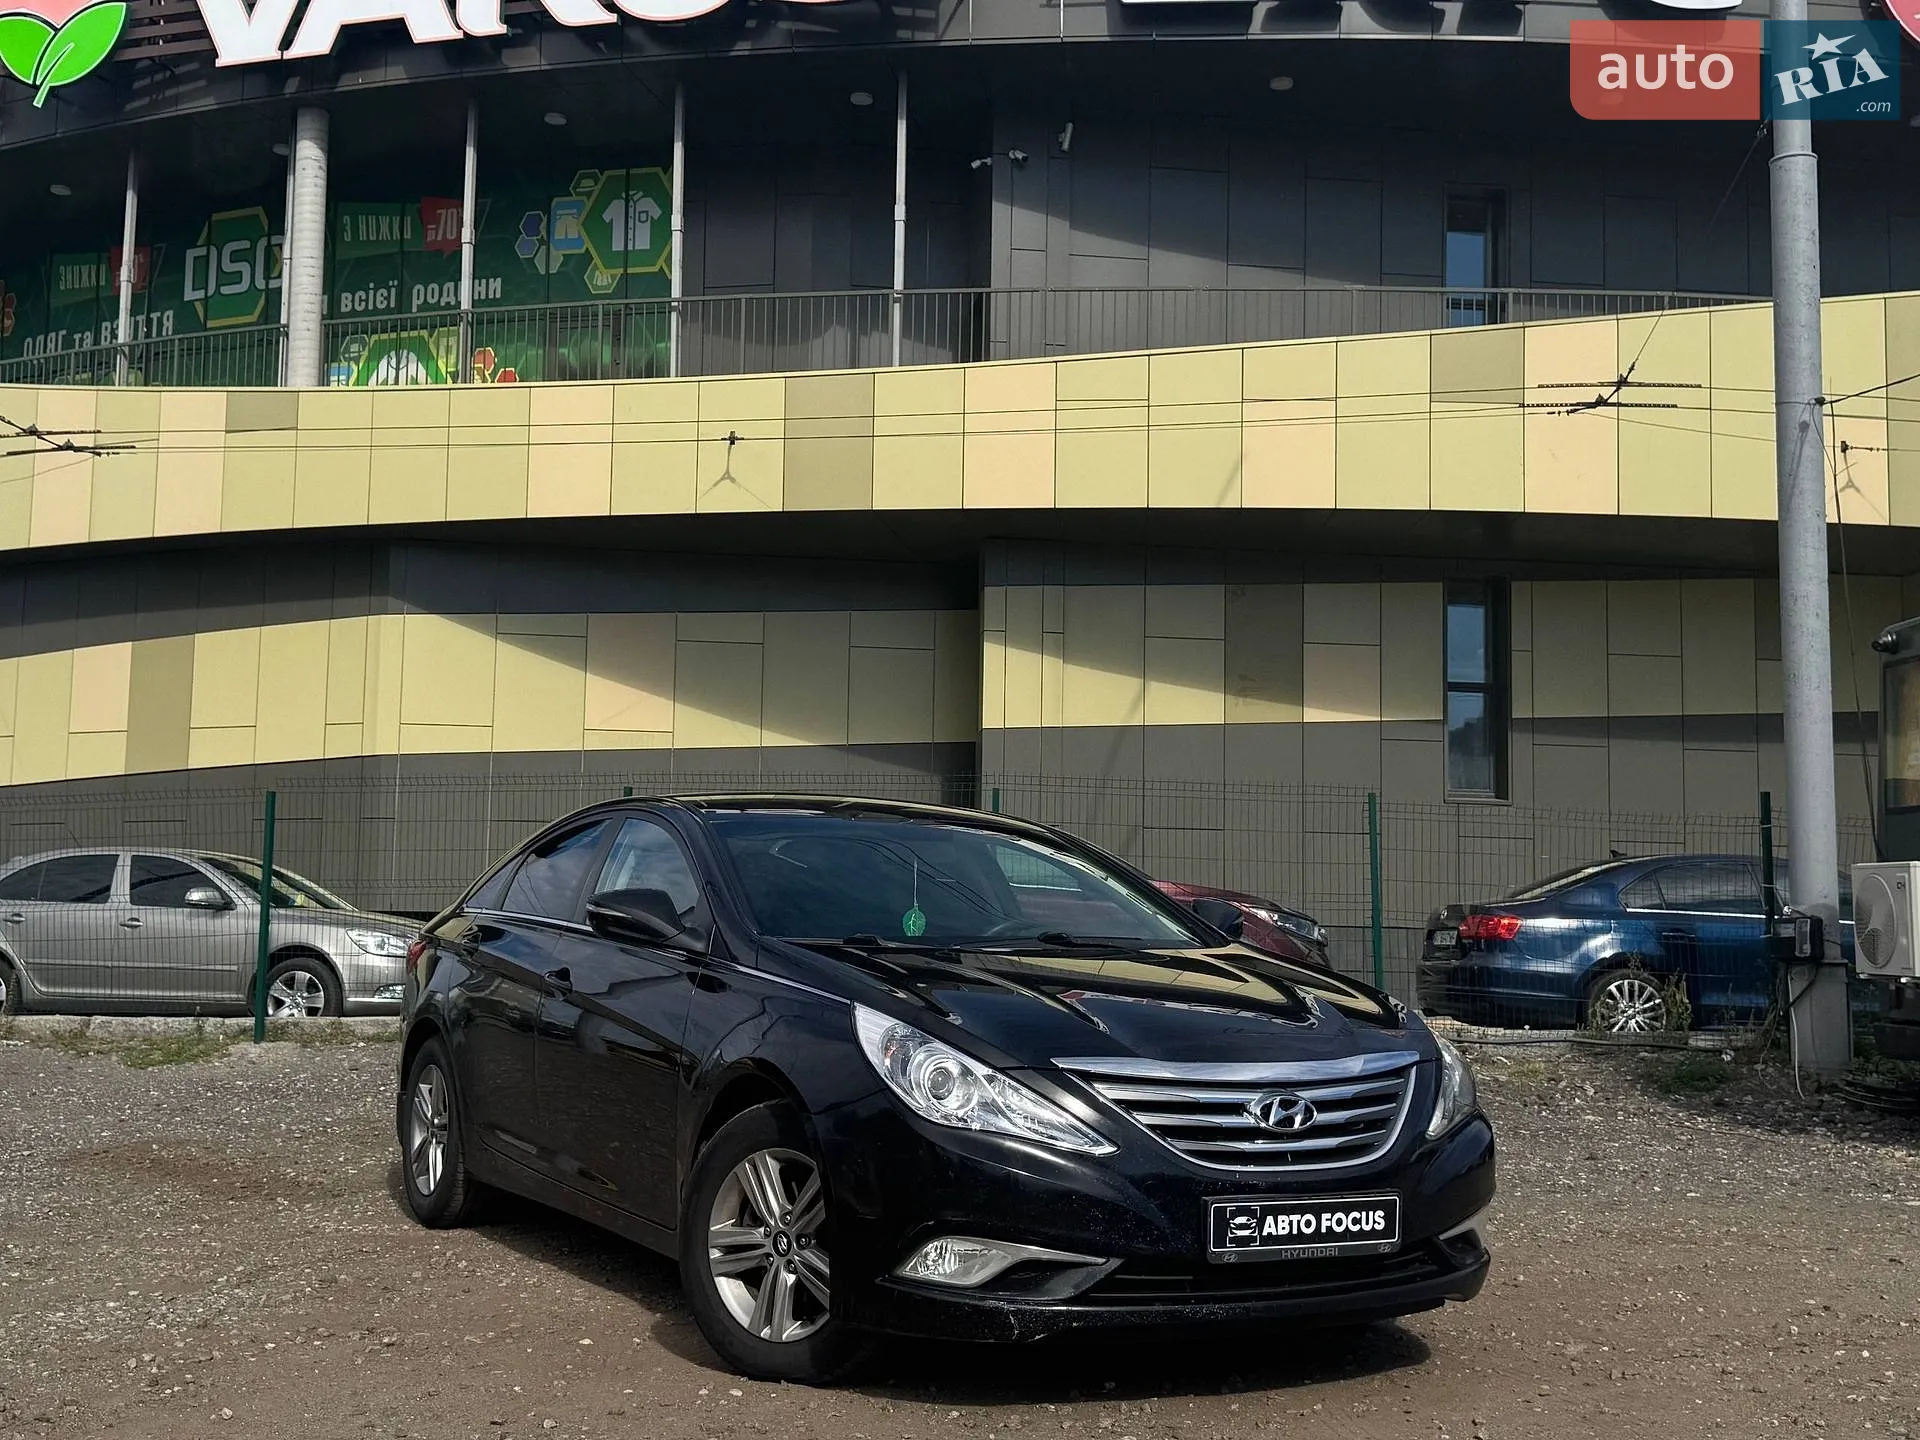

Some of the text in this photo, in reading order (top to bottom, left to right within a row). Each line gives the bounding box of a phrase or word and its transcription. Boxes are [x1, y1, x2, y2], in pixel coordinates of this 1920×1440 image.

[411, 276, 502, 313] родни
[1320, 1210, 1386, 1233] FOCUS
[1281, 1247, 1339, 1260] HYUNDAI
